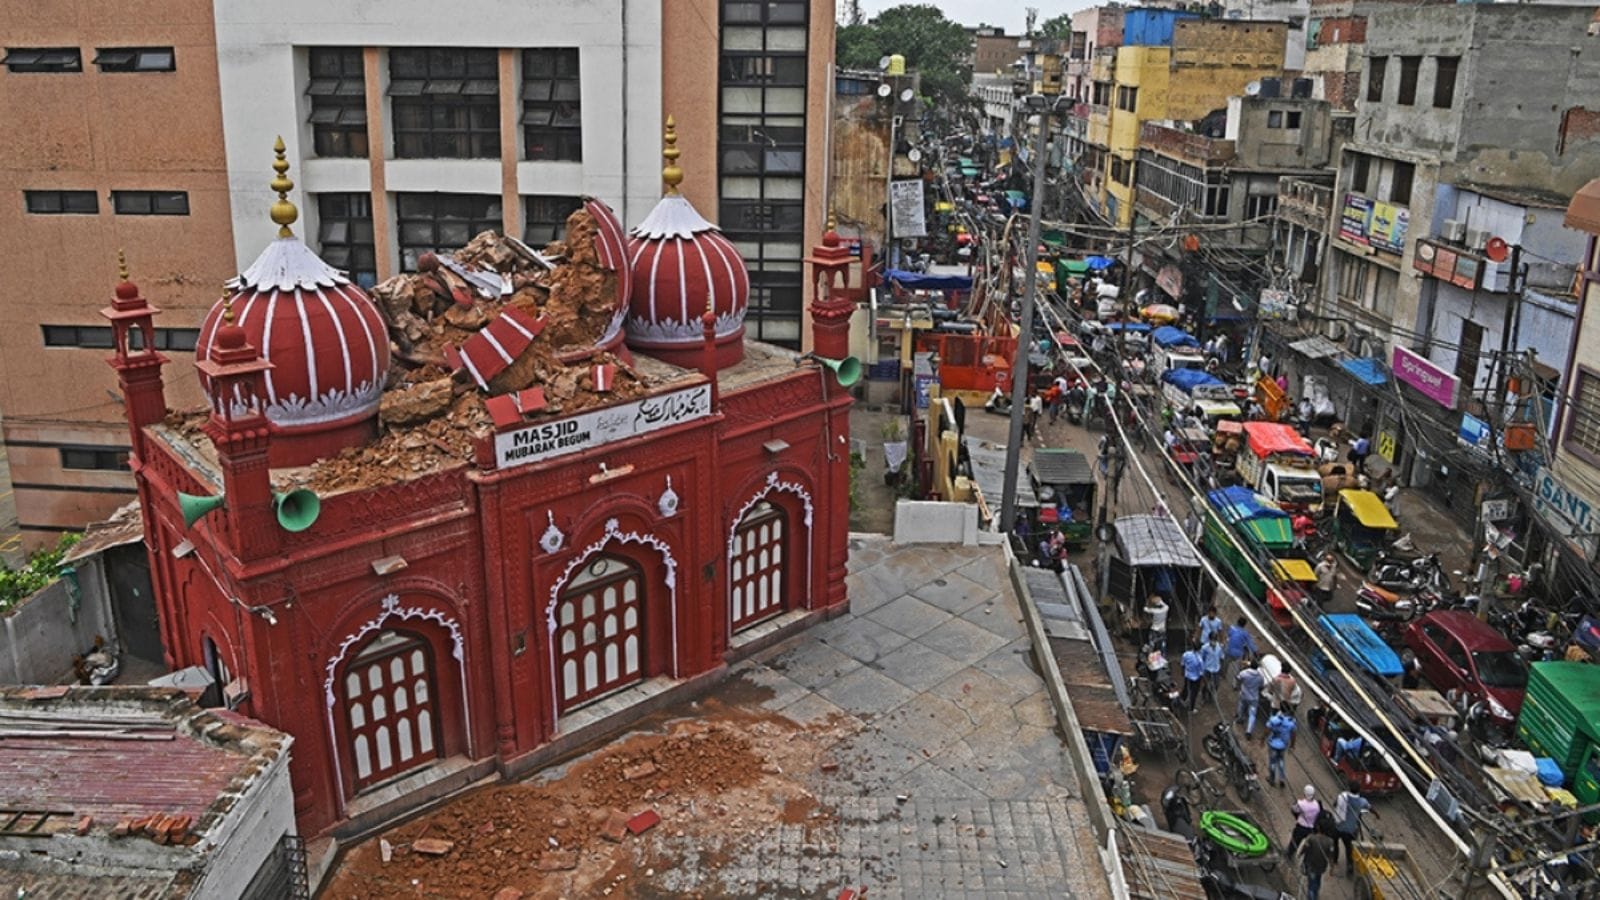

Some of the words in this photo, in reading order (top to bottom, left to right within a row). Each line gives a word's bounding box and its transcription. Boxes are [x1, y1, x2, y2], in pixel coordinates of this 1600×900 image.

[504, 440, 556, 462] MUBARAK
[557, 431, 591, 449] BEGUM
[513, 420, 578, 446] MASJID
